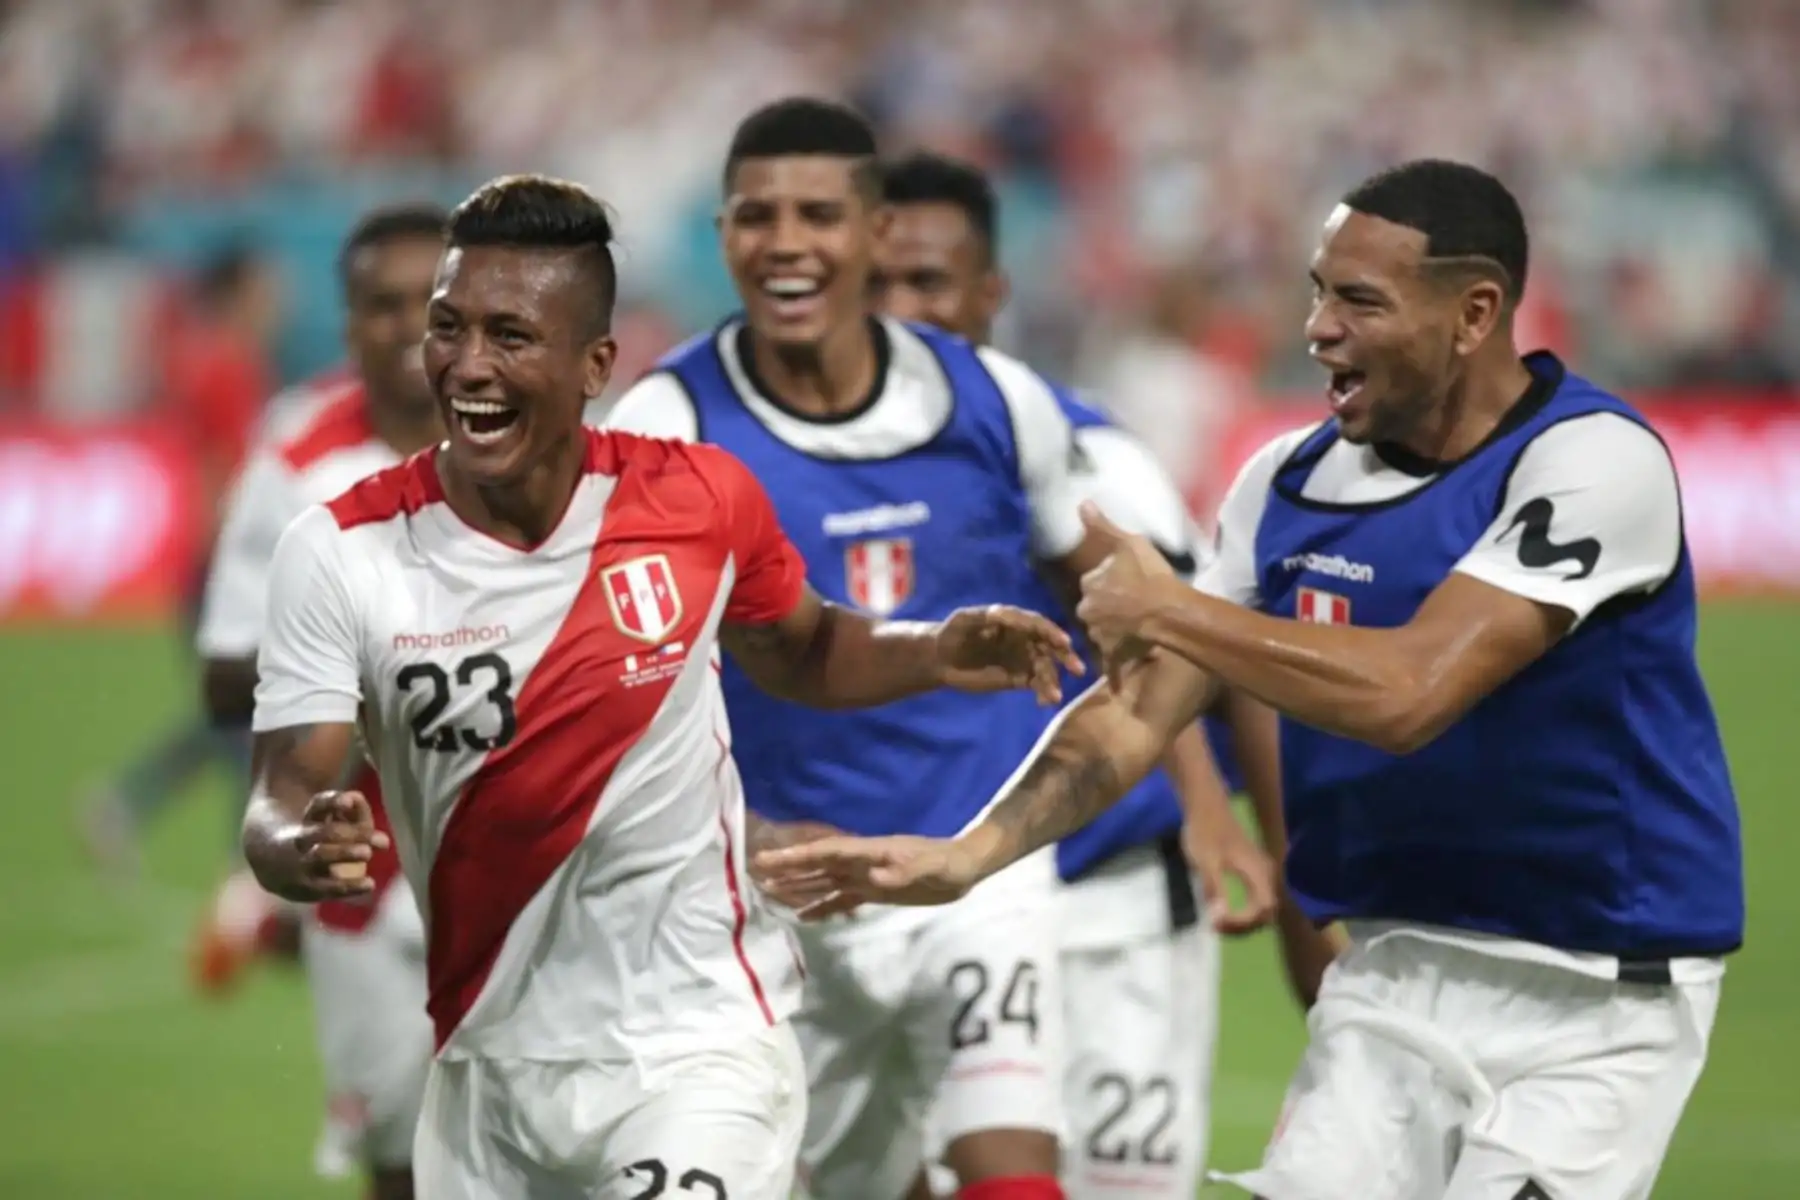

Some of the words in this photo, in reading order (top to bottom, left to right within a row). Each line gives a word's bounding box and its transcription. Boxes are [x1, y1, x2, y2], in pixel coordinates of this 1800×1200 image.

[394, 623, 509, 650] marathon
[396, 653, 516, 753] 23
[947, 958, 1039, 1050] 24
[1087, 1073, 1177, 1164] 22
